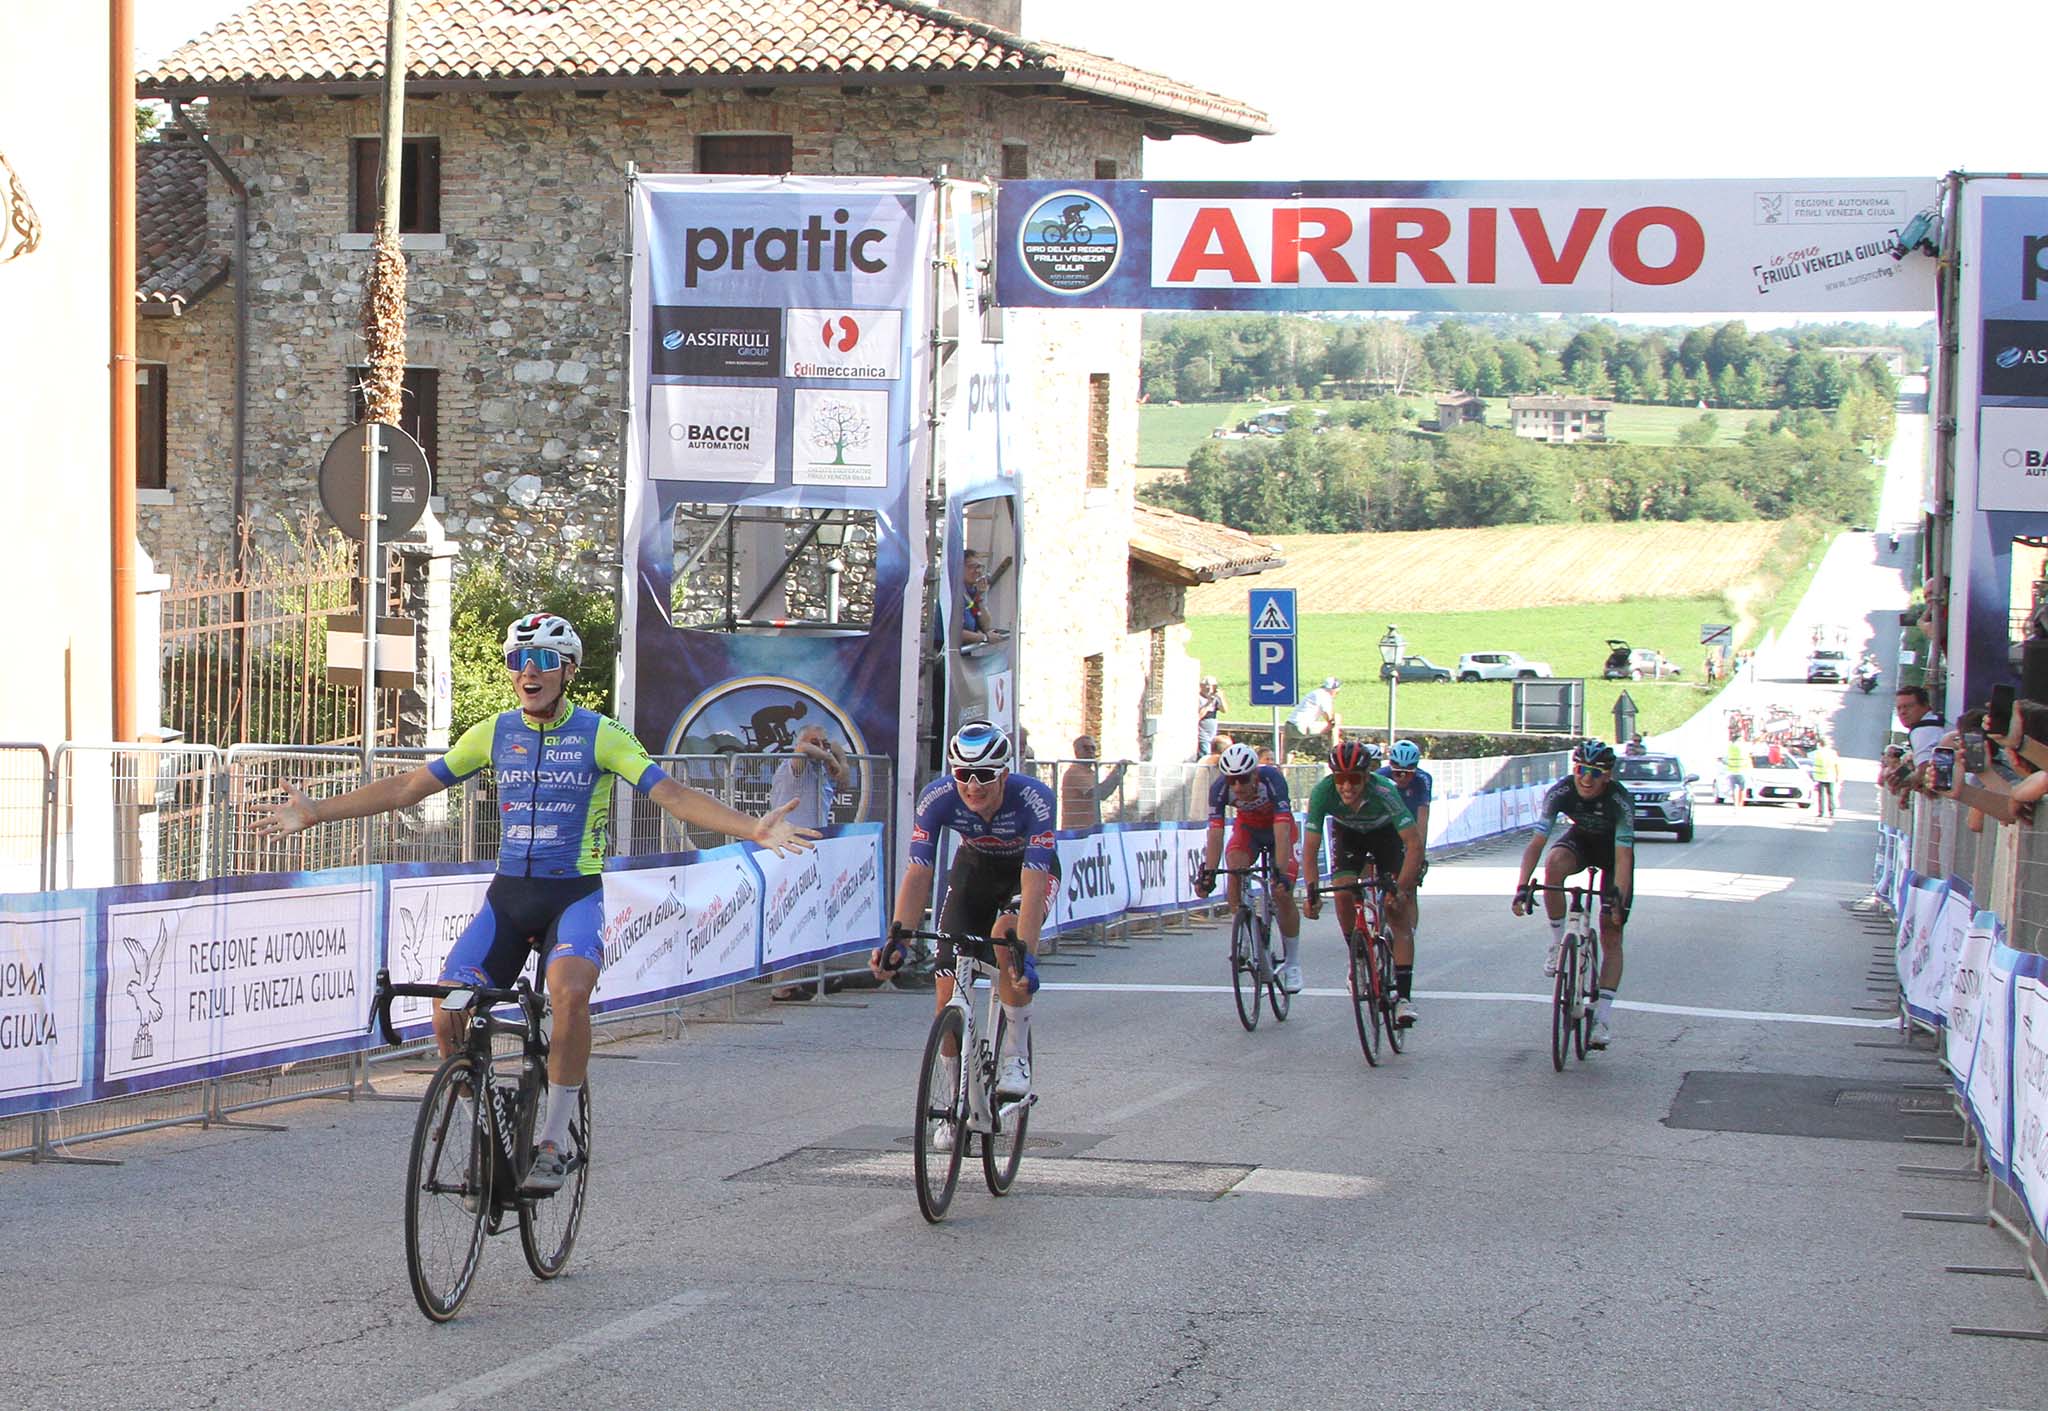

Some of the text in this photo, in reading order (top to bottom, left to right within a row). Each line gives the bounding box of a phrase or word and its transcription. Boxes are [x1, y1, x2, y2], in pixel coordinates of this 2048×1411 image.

[1825, 208, 1864, 217] VENEZIA
[1838, 199, 1889, 207] AUTONOMA
[684, 208, 888, 288] pratic
[1025, 245, 1046, 253] GIRO
[1077, 246, 1114, 254] REGIONE
[1166, 205, 1705, 285] ARRIVO
[1064, 254, 1106, 263] VENEZIA
[1762, 239, 1896, 286] FRIULI VENEZIA GIULIA
[1769, 245, 1820, 267] io sono
[685, 332, 769, 348] ASSIFRIULI
[737, 347, 769, 357] GROUP
[688, 425, 750, 442] BACCI
[688, 441, 750, 451] AUTOMATION
[1259, 641, 1285, 675] P
[545, 749, 583, 763] Rime
[507, 801, 577, 814] CIPOLLINI
[1019, 785, 1051, 822] Alpecin
[620, 910, 653, 954] VENEZIA
[189, 926, 348, 976] REGIONE AUTONOMA
[188, 968, 356, 1023] FRIULI VENEZIA GIULIA
[0, 1011, 58, 1050] GIULIA
